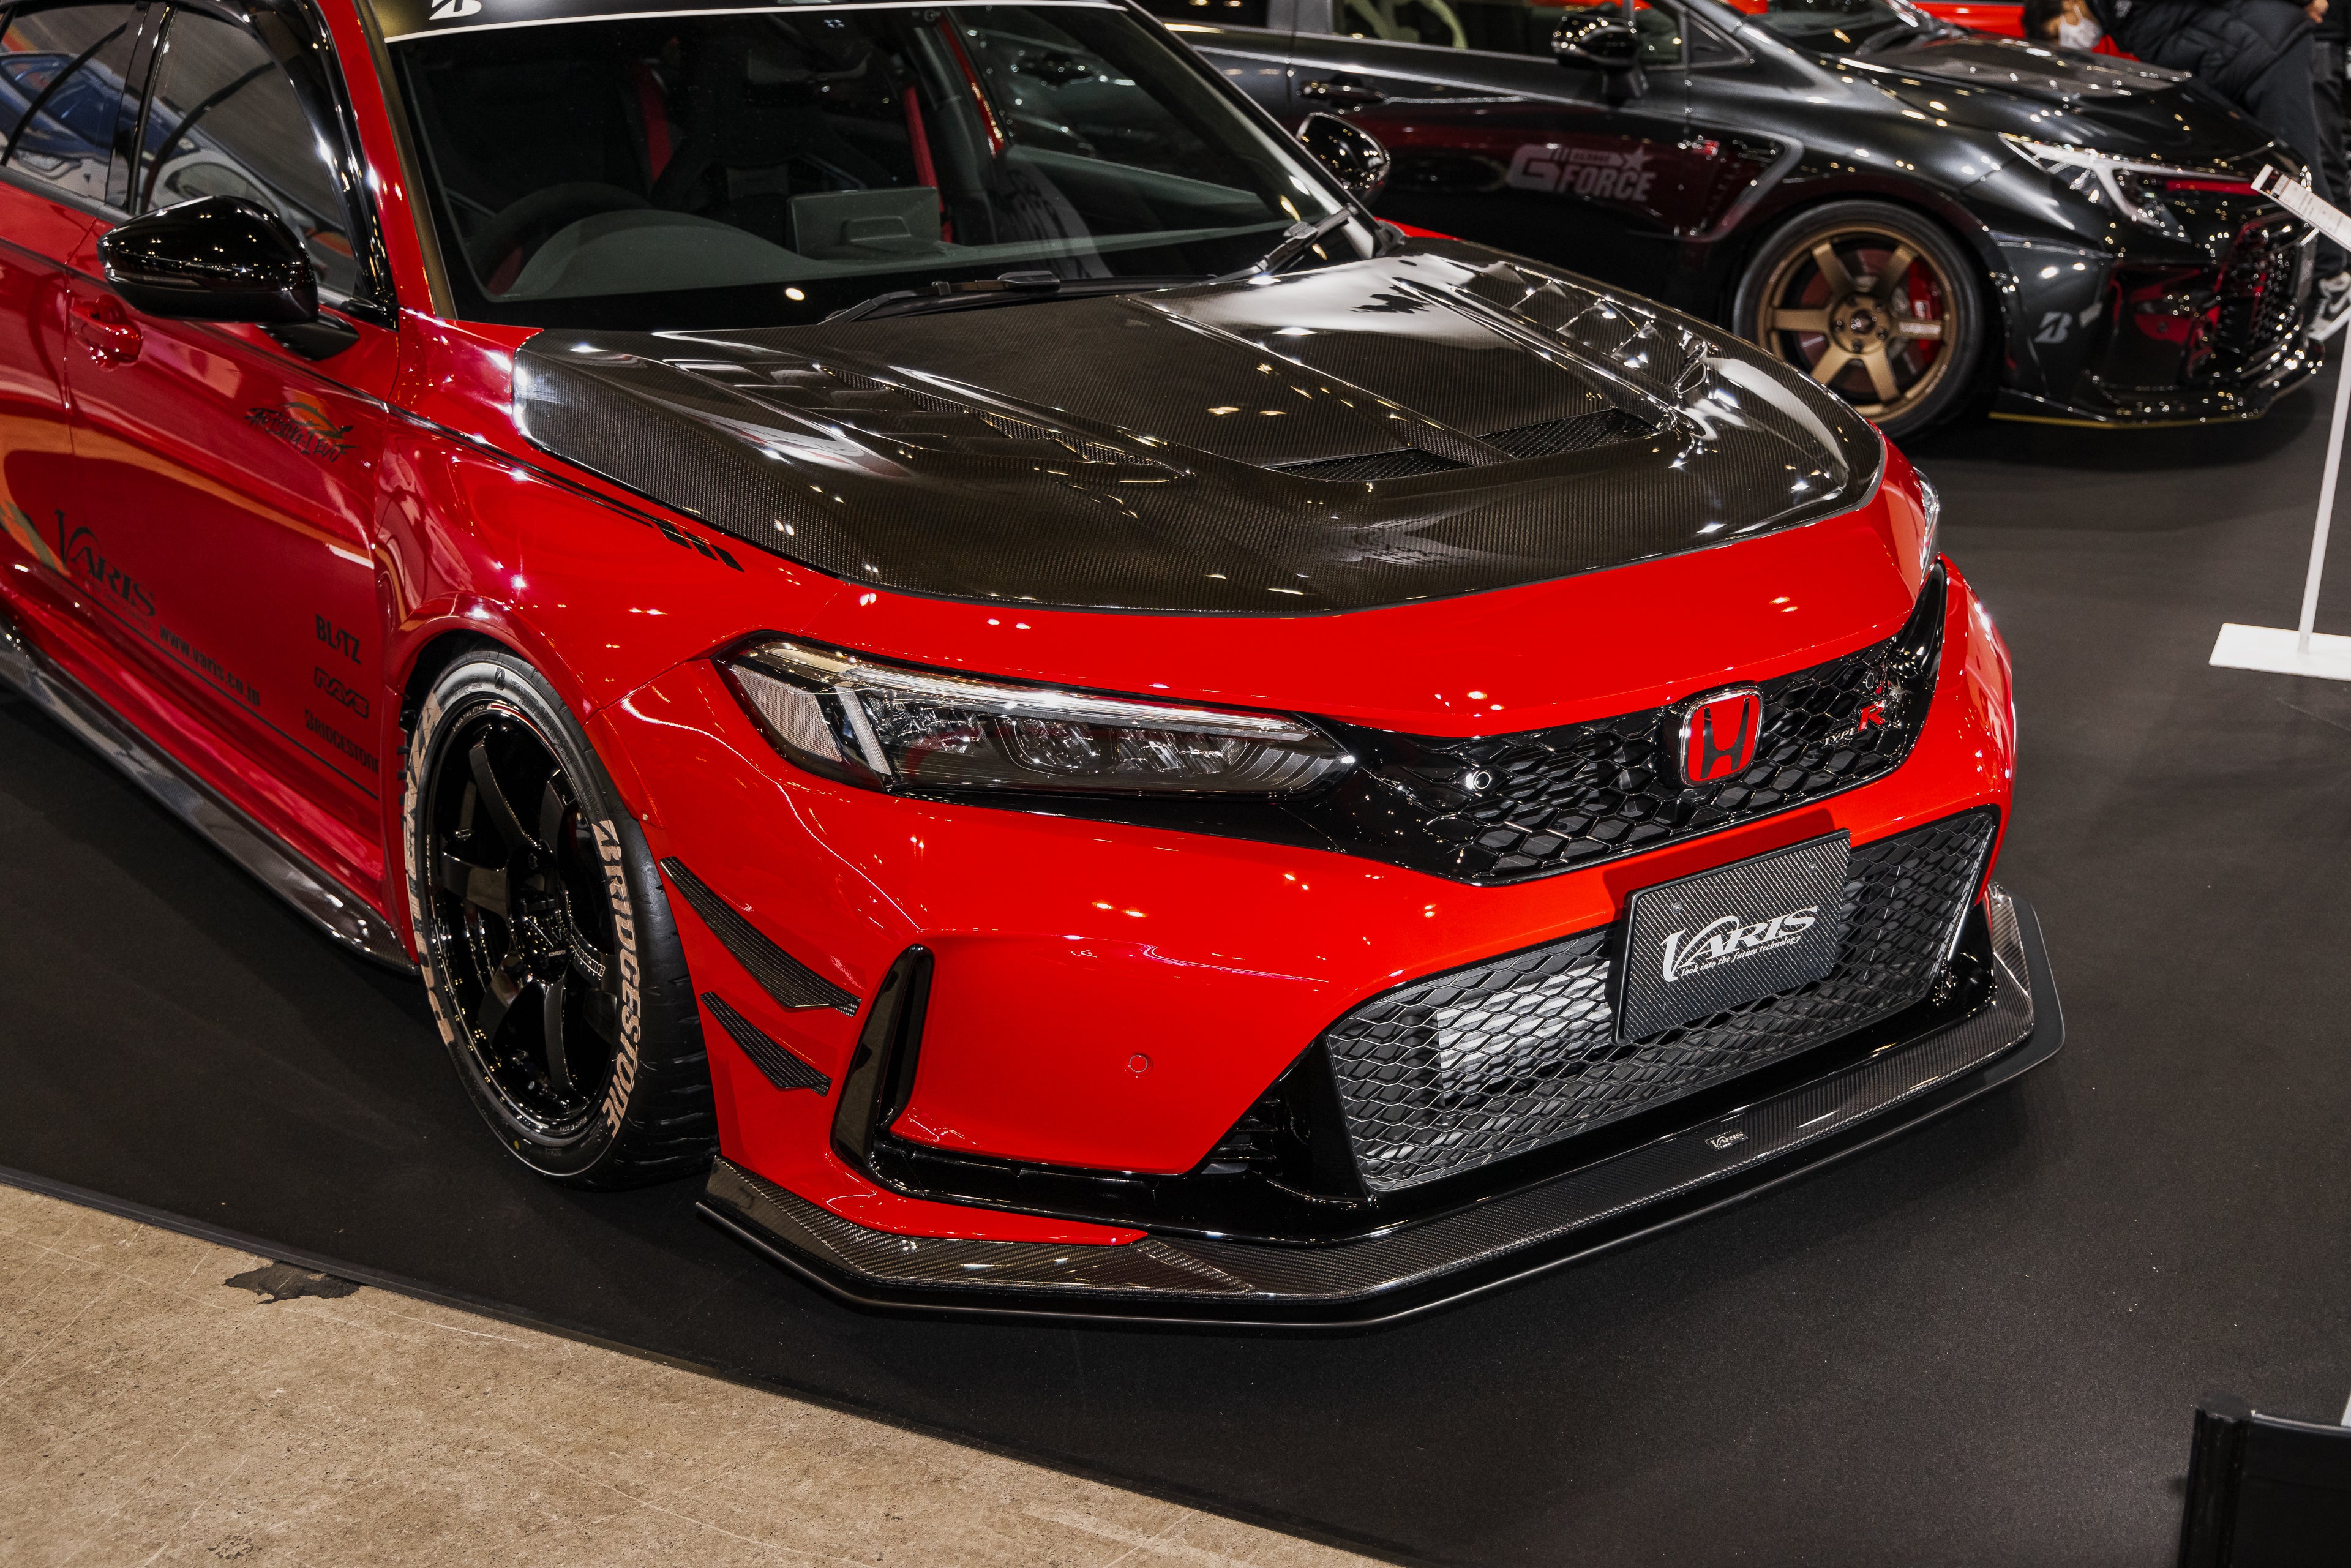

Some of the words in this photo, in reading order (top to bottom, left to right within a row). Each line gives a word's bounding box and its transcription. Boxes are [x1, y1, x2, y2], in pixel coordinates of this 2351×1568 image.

[1558, 163, 1657, 201] FORCE
[54, 509, 156, 617] VARIS
[159, 623, 261, 707] www.varis.co.jp
[315, 612, 361, 665] BLITZ
[313, 666, 369, 719] RAYS
[1821, 727, 1858, 748] TYPE
[1858, 701, 1886, 733] R
[1660, 906, 1818, 982] VARIS
[1681, 964, 1698, 977] look
[1700, 961, 1717, 971] into
[1717, 956, 1730, 965] the
[1731, 948, 1757, 963] future
[1759, 935, 1801, 952] technology
[591, 819, 640, 1138] BRIDGESTONE
[1710, 1131, 1744, 1149] VARIS
